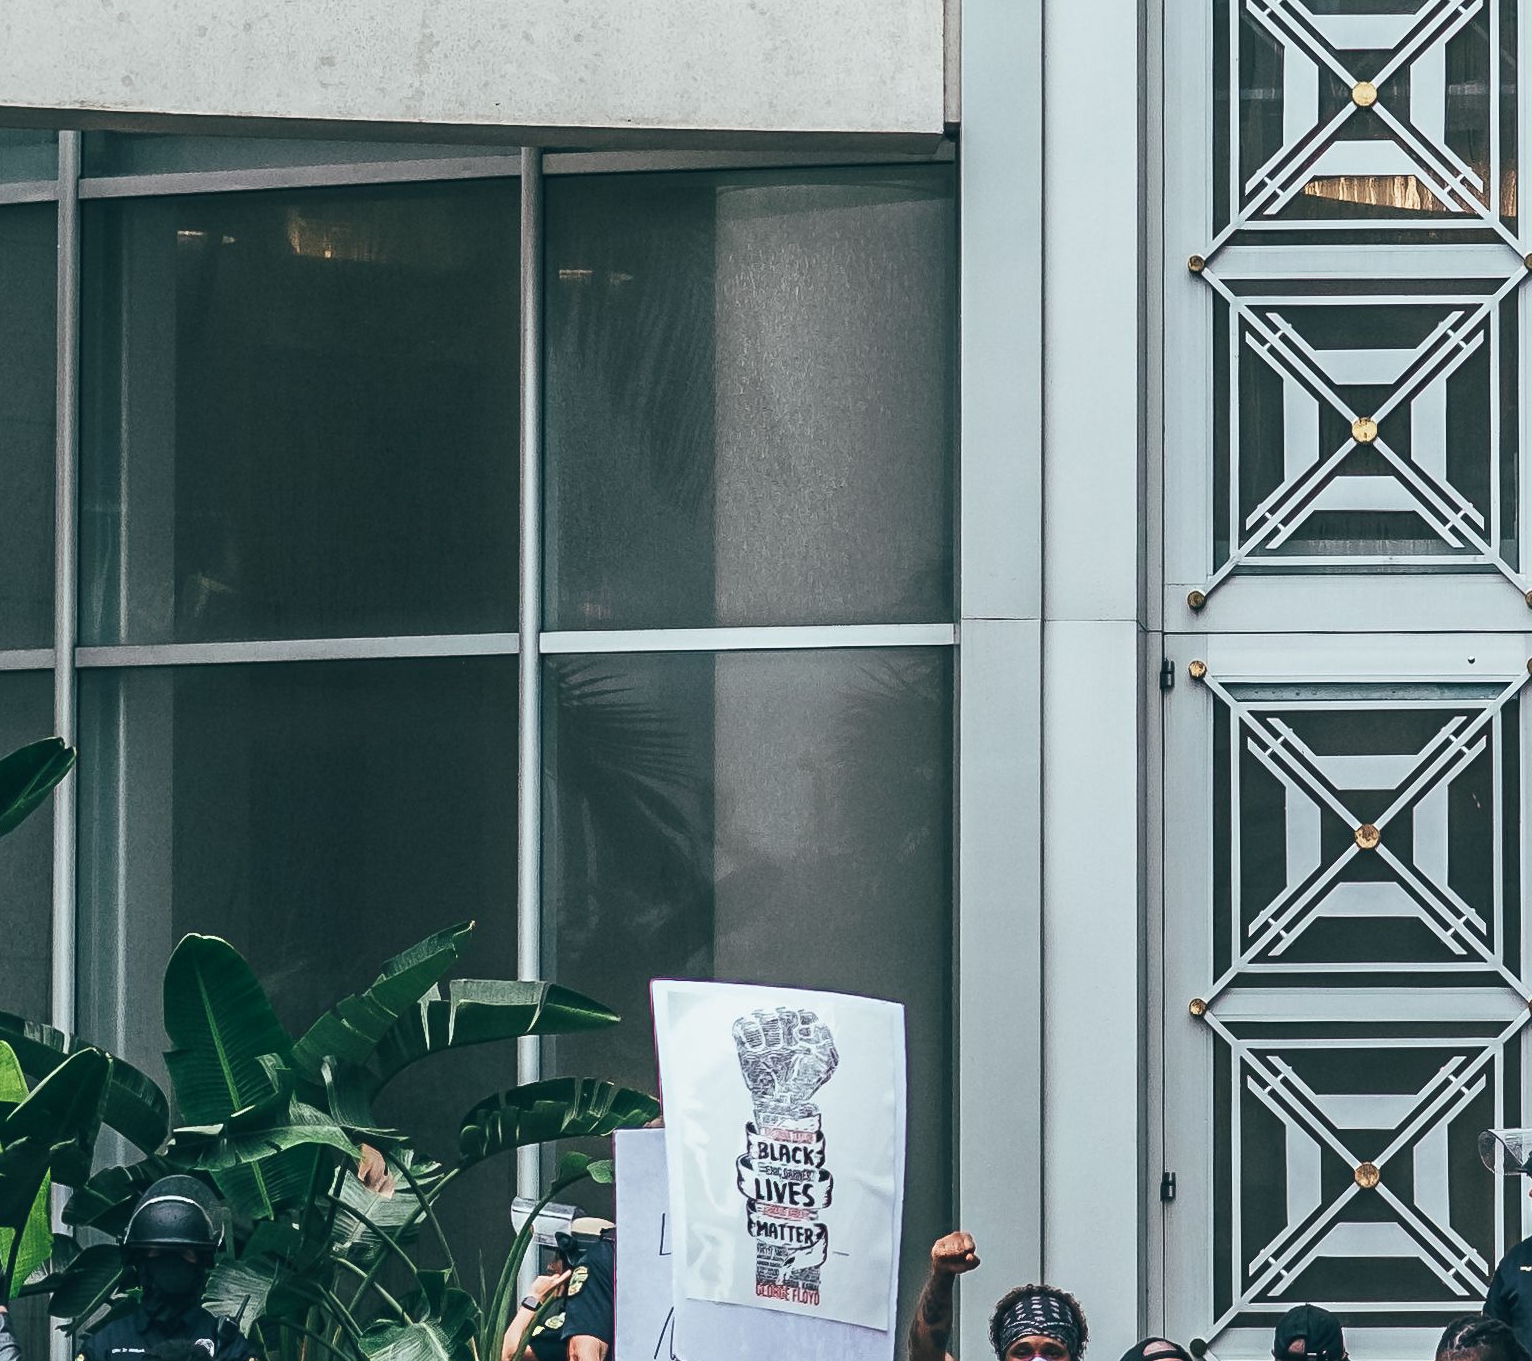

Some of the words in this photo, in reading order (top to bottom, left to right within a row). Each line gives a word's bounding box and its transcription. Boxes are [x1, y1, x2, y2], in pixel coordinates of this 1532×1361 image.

[758, 1142, 814, 1167] BLACK
[755, 1178, 815, 1207] LIVES
[757, 1220, 813, 1245] MATTER
[793, 1287, 820, 1306] FLOYD
